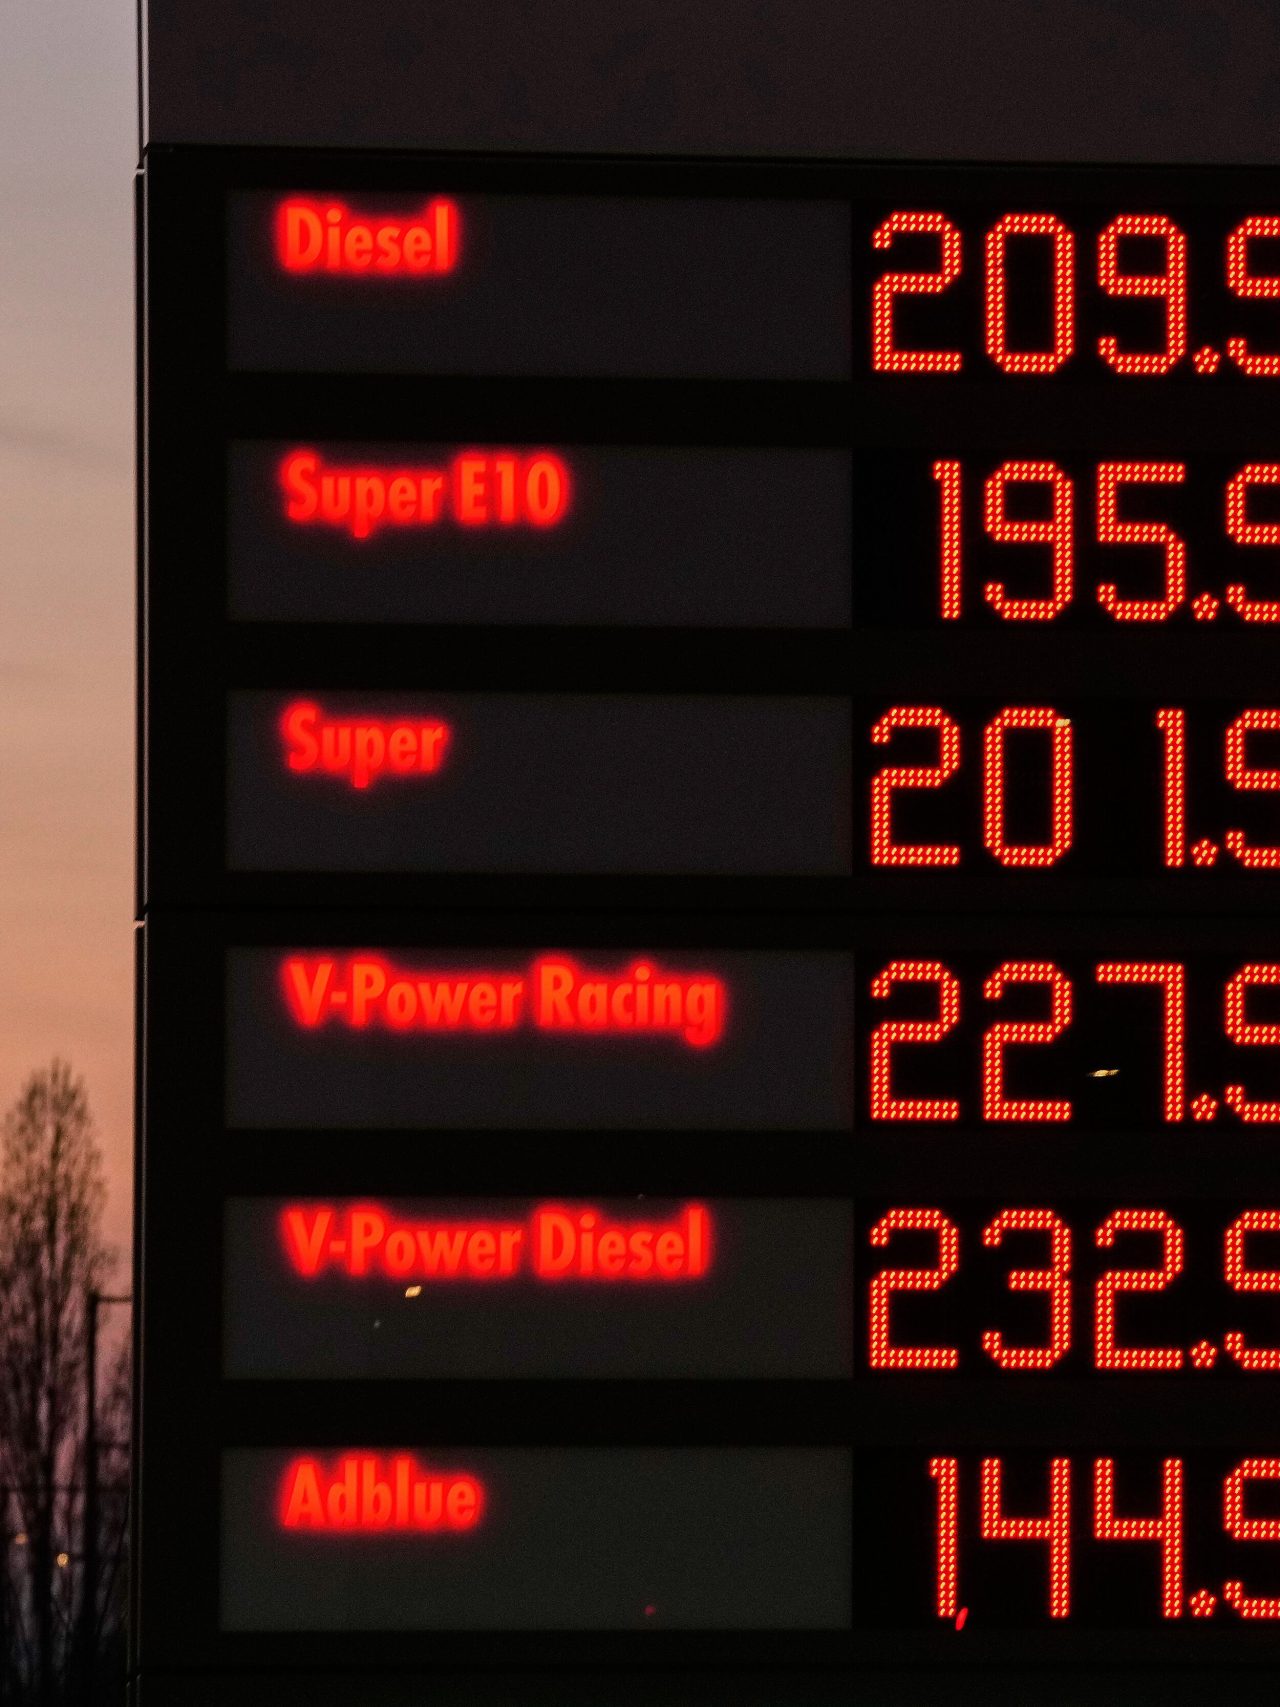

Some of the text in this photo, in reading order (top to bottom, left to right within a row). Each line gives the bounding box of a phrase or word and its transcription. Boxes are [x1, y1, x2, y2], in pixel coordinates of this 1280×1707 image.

[284, 204, 450, 267] Diesel
[285, 456, 444, 536] Super
[459, 457, 563, 522] E10
[286, 707, 444, 788] Super
[287, 961, 523, 1023] V-Power
[538, 963, 717, 1044] Racing
[286, 1210, 523, 1270] V-Power
[537, 1209, 704, 1271] Diesel
[284, 1457, 478, 1522] Adblue
